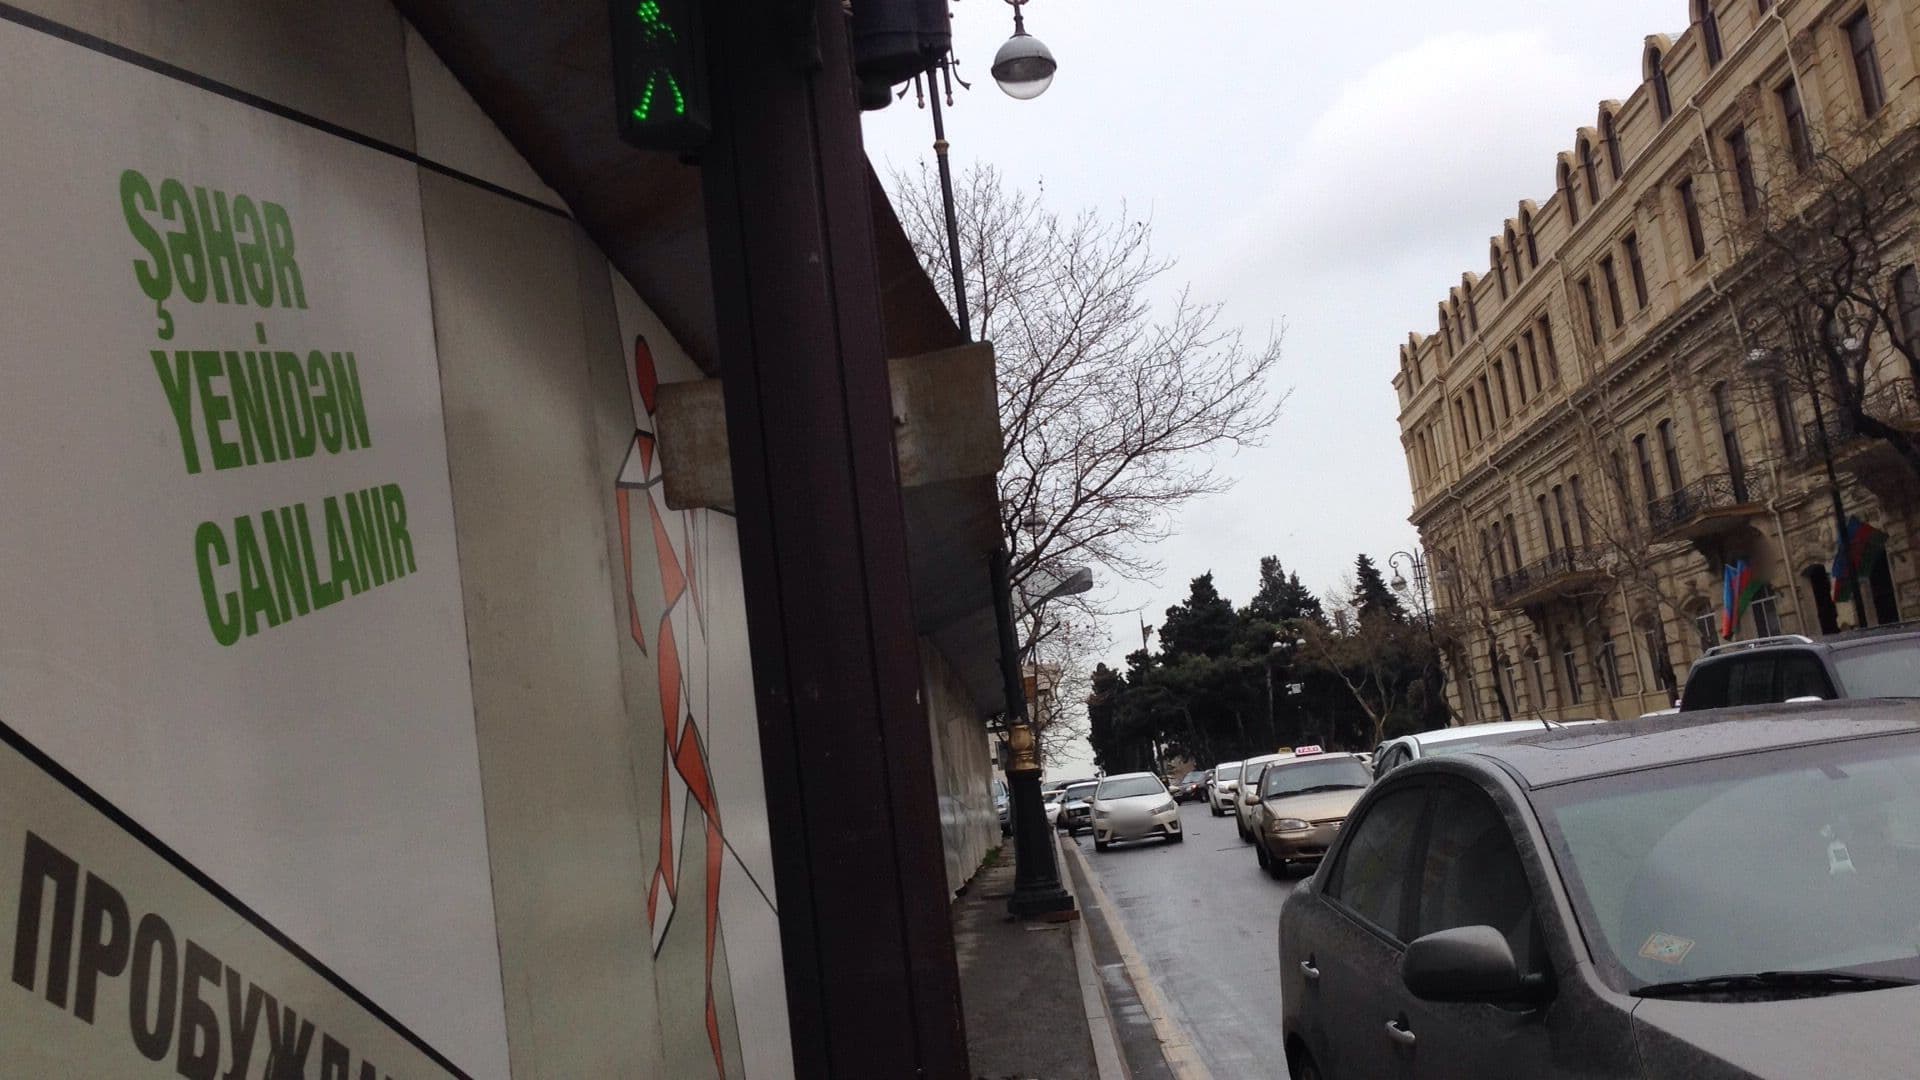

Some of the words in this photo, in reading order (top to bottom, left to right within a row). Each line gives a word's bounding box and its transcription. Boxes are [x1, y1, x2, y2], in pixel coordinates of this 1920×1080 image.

[119, 169, 308, 340] ŞƏHƏR
[150, 321, 371, 474] YENİDƏN
[195, 483, 417, 646] CANLANIR
